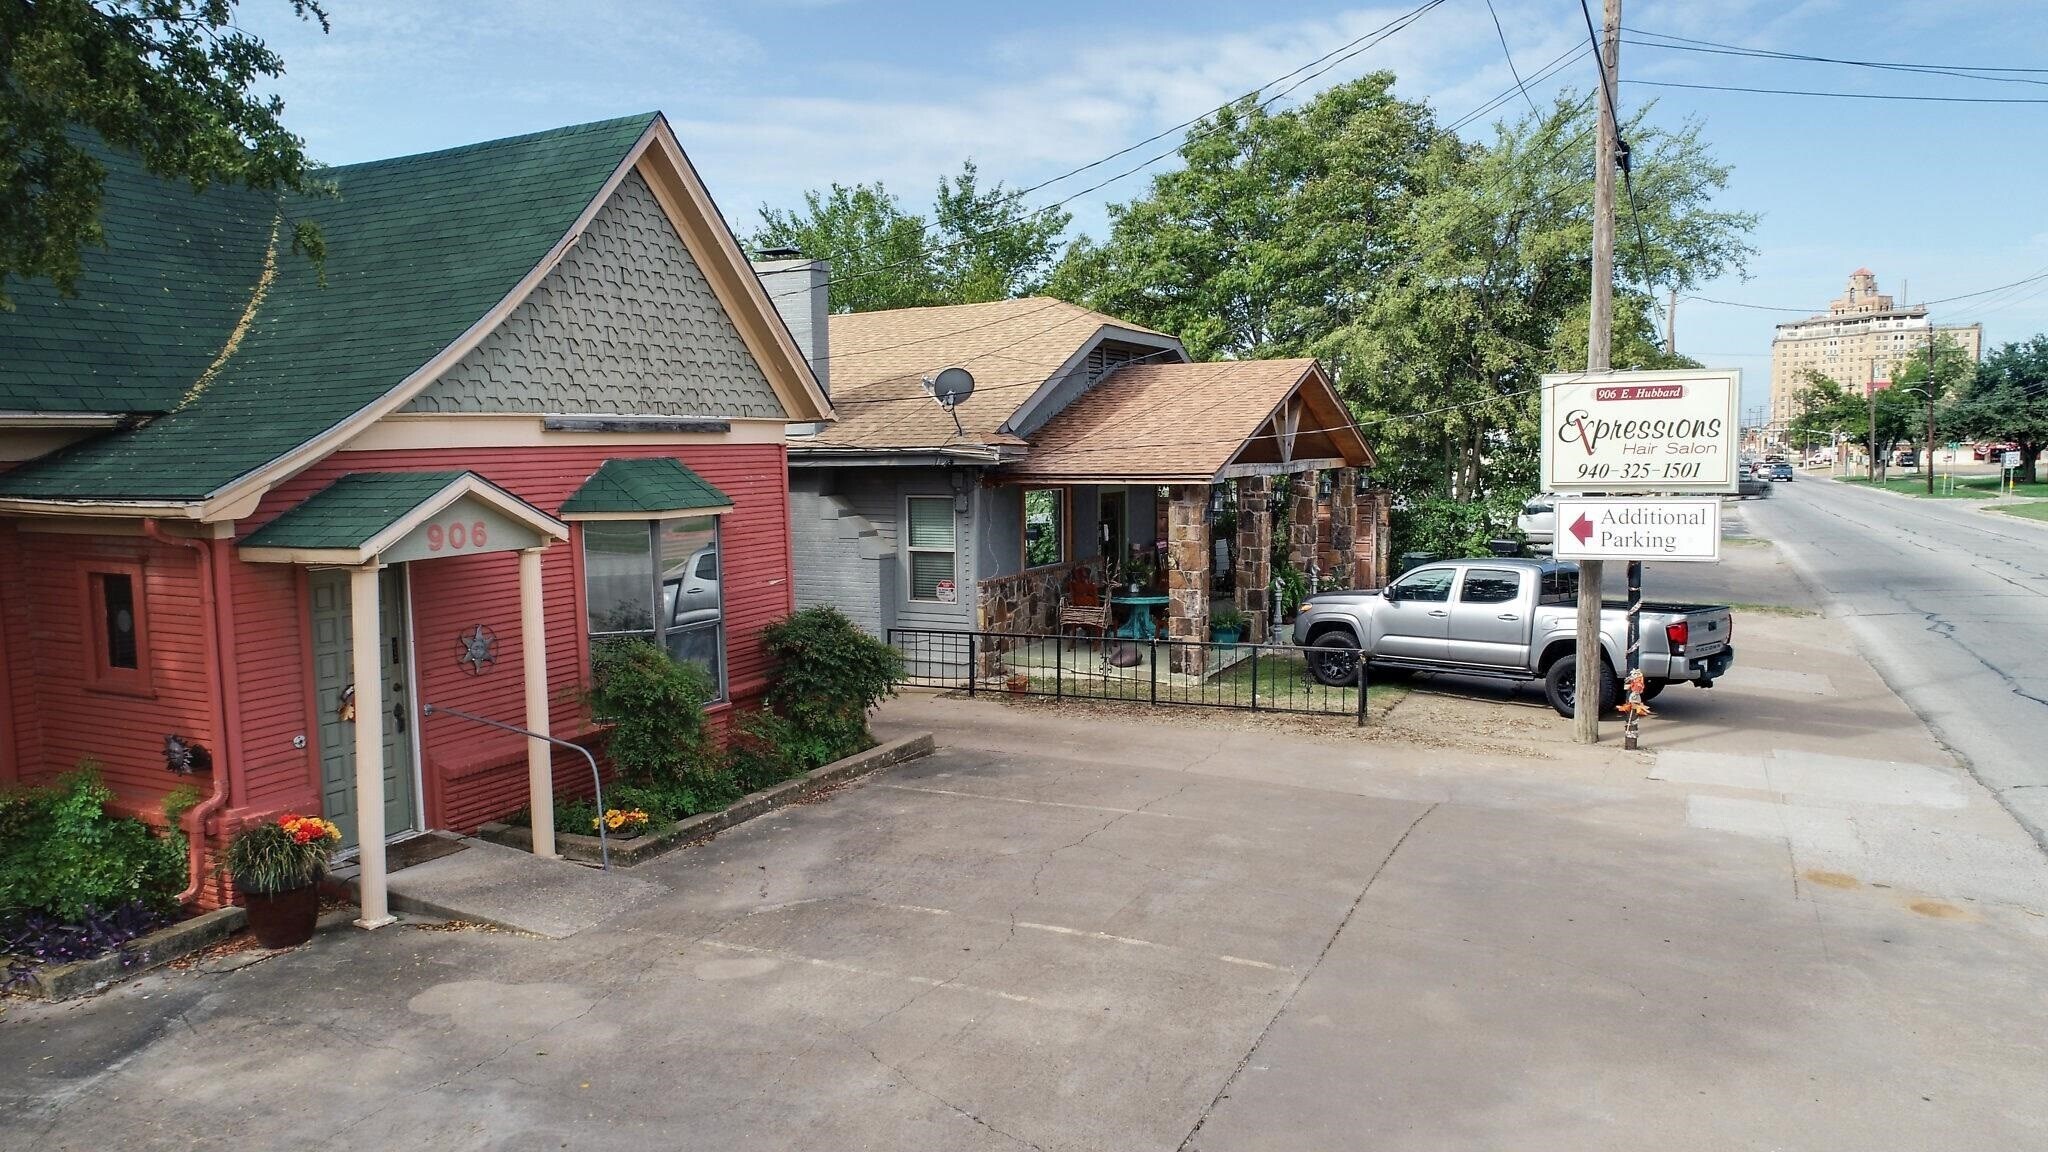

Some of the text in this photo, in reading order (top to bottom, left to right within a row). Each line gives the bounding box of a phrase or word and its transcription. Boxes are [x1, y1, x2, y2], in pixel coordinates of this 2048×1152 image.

[1599, 387, 1681, 399] 906 E. Hubbard
[1558, 409, 1721, 456] Expressions
[1622, 442, 1718, 455] Hair Salon
[1577, 462, 1701, 479] 940-325-1501
[1601, 508, 1706, 526] Additional
[427, 522, 487, 551] 906
[1601, 531, 1676, 552] Parking
